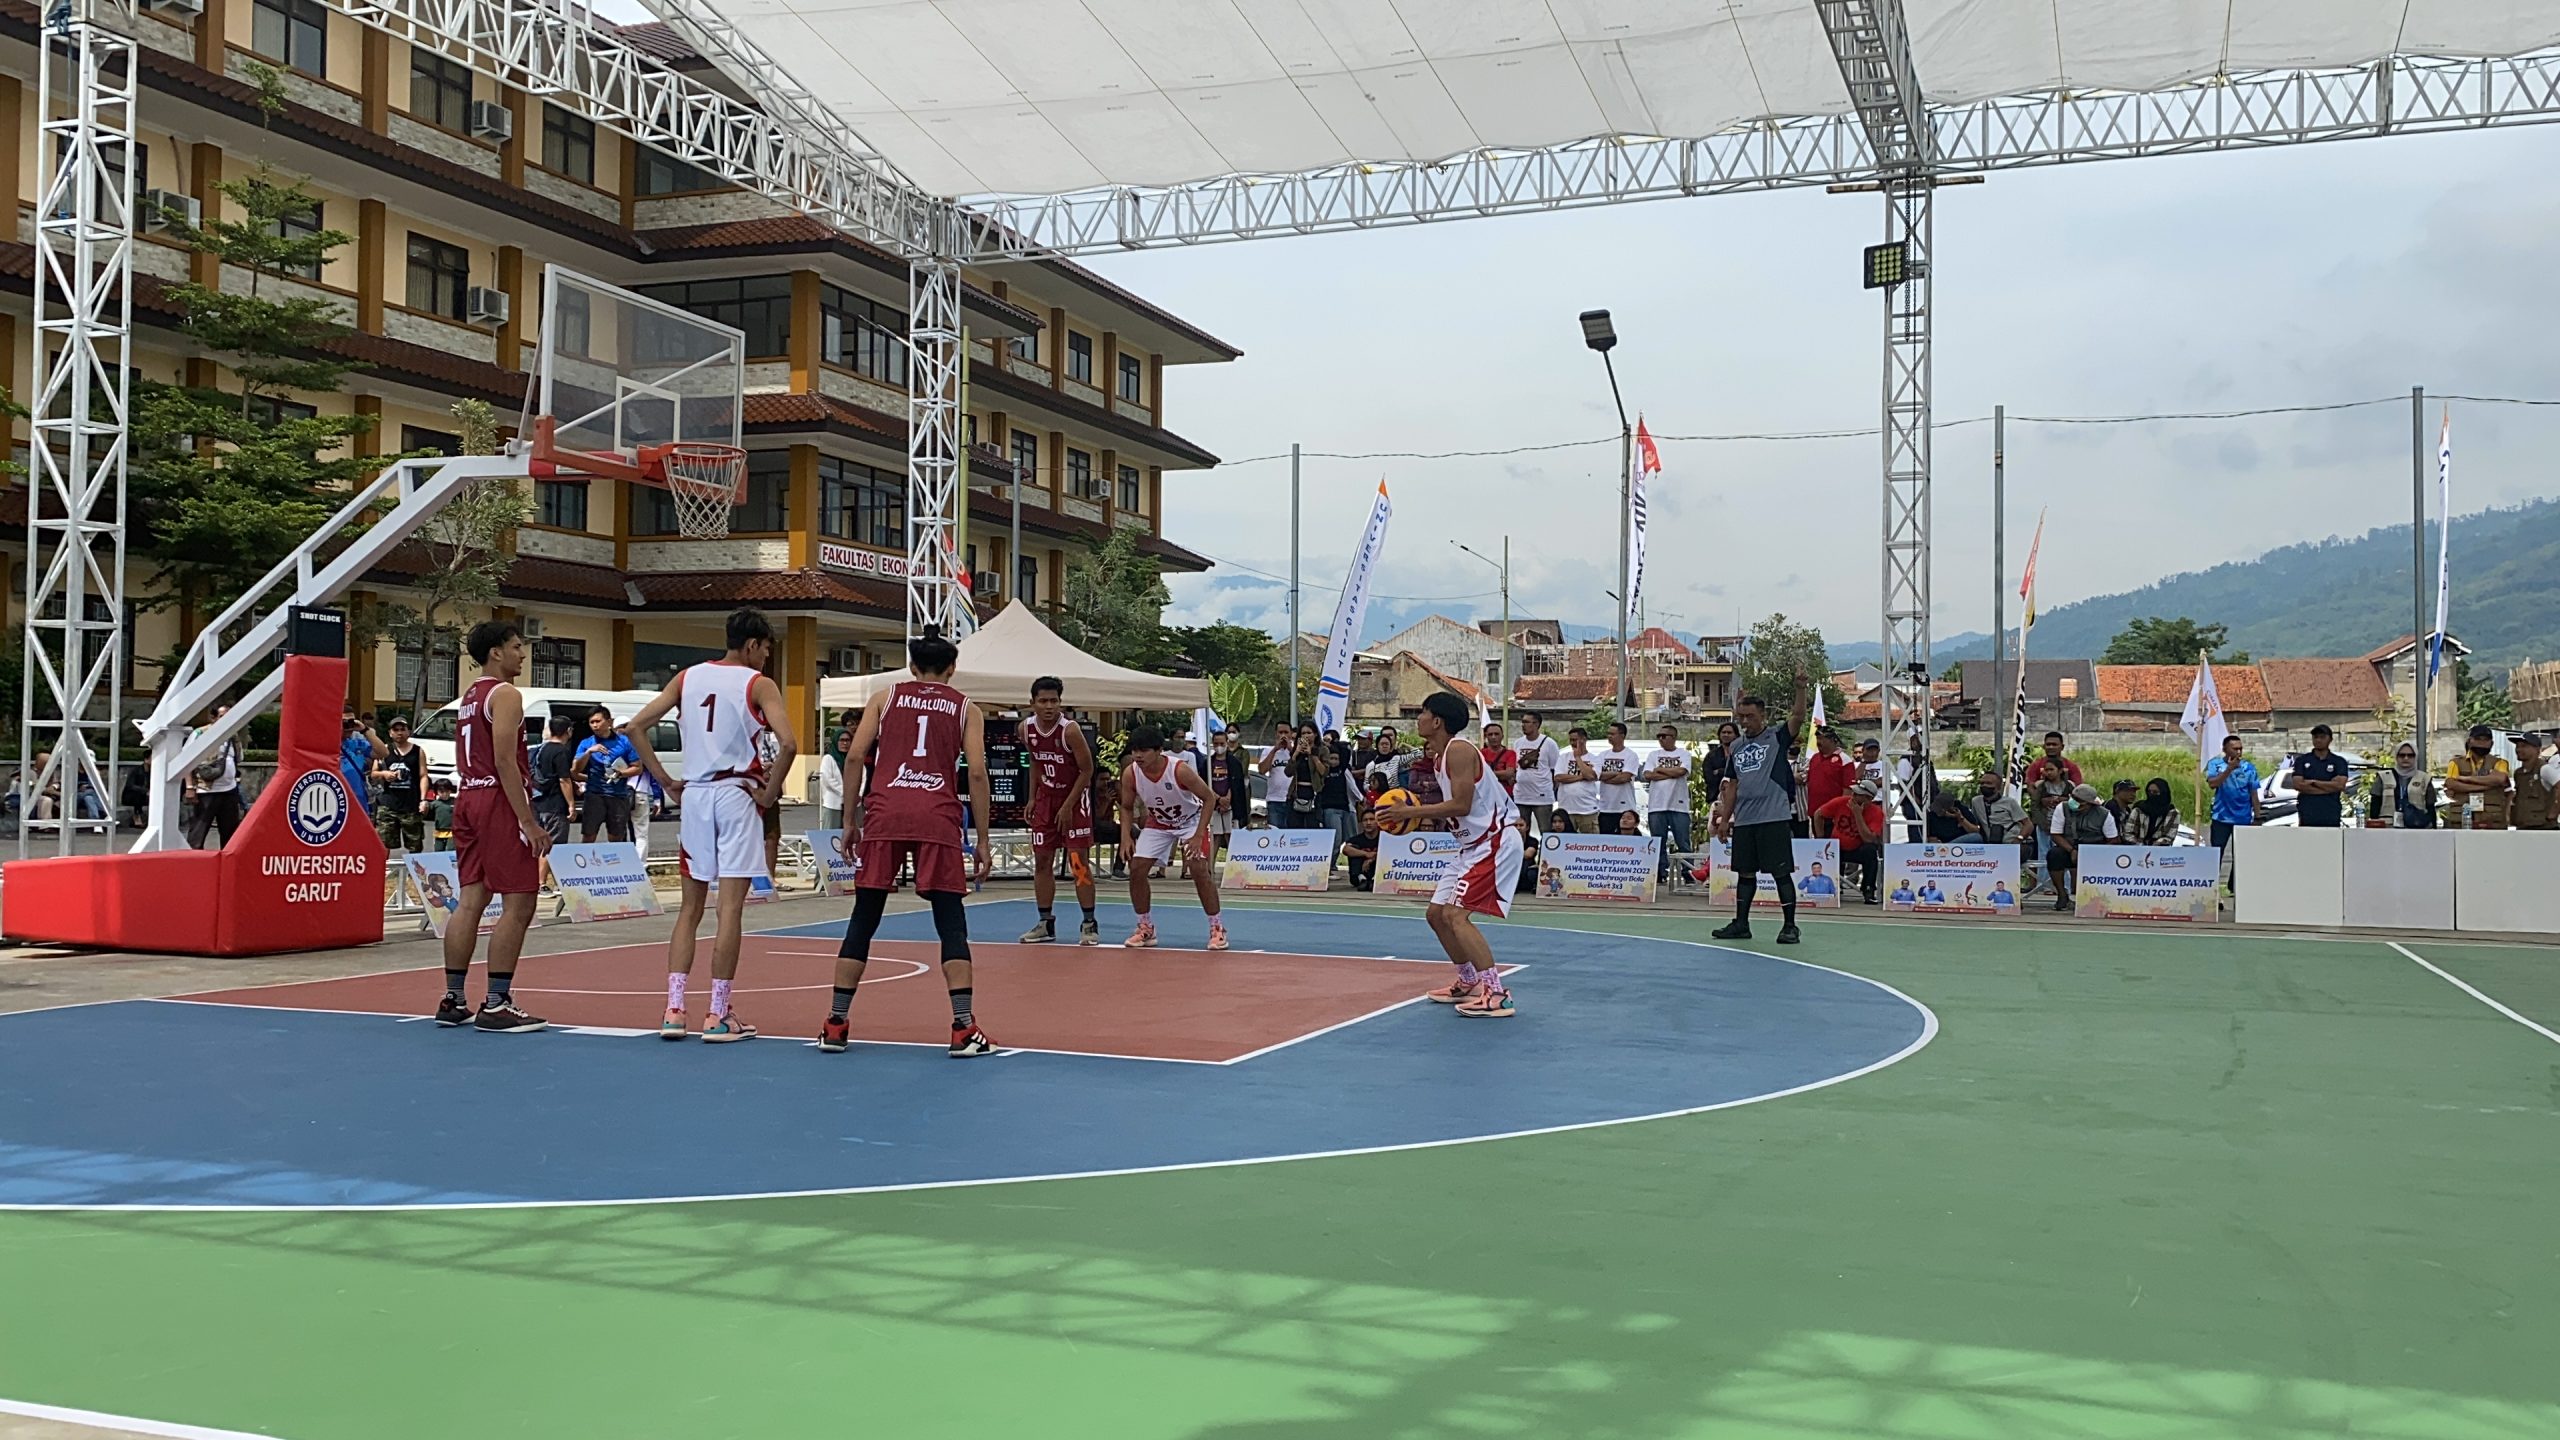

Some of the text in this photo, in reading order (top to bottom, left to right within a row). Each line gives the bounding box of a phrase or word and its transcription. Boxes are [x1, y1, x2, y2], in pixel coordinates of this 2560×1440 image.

[822, 545, 927, 576] FAKULTAS EKONOM
[300, 612, 341, 623] SHOT CLOCK
[896, 695, 957, 716] AKMALUDIN
[700, 694, 716, 732] 1
[913, 716, 928, 757] 1
[1044, 764, 1055, 777] 10
[902, 769, 943, 785] Subang
[290, 773, 345, 812] UNIVERSITAS GARUT
[991, 794, 1015, 802] TIMER
[301, 831, 333, 842] UNIGA
[1033, 832, 1044, 845] 10
[1564, 843, 1634, 855] Selamat Datang
[262, 855, 366, 875] UNIVERSITAS
[1392, 859, 1433, 869] Selamat
[1601, 858, 1629, 866] Porprov
[1906, 859, 1998, 869] Selamat Bertanding!
[560, 877, 595, 887] PORPROV
[625, 874, 645, 883] BARAT
[1383, 871, 1442, 881] di Universit
[1568, 873, 1594, 881] Cabang
[1595, 874, 1627, 882] Olahraga
[2082, 876, 2214, 887] PORPROV XIV JAWA BARAT
[285, 882, 342, 902] GARUT
[589, 887, 629, 896] TAHUN 2022
[2117, 888, 2177, 898] TAHUN 2022
